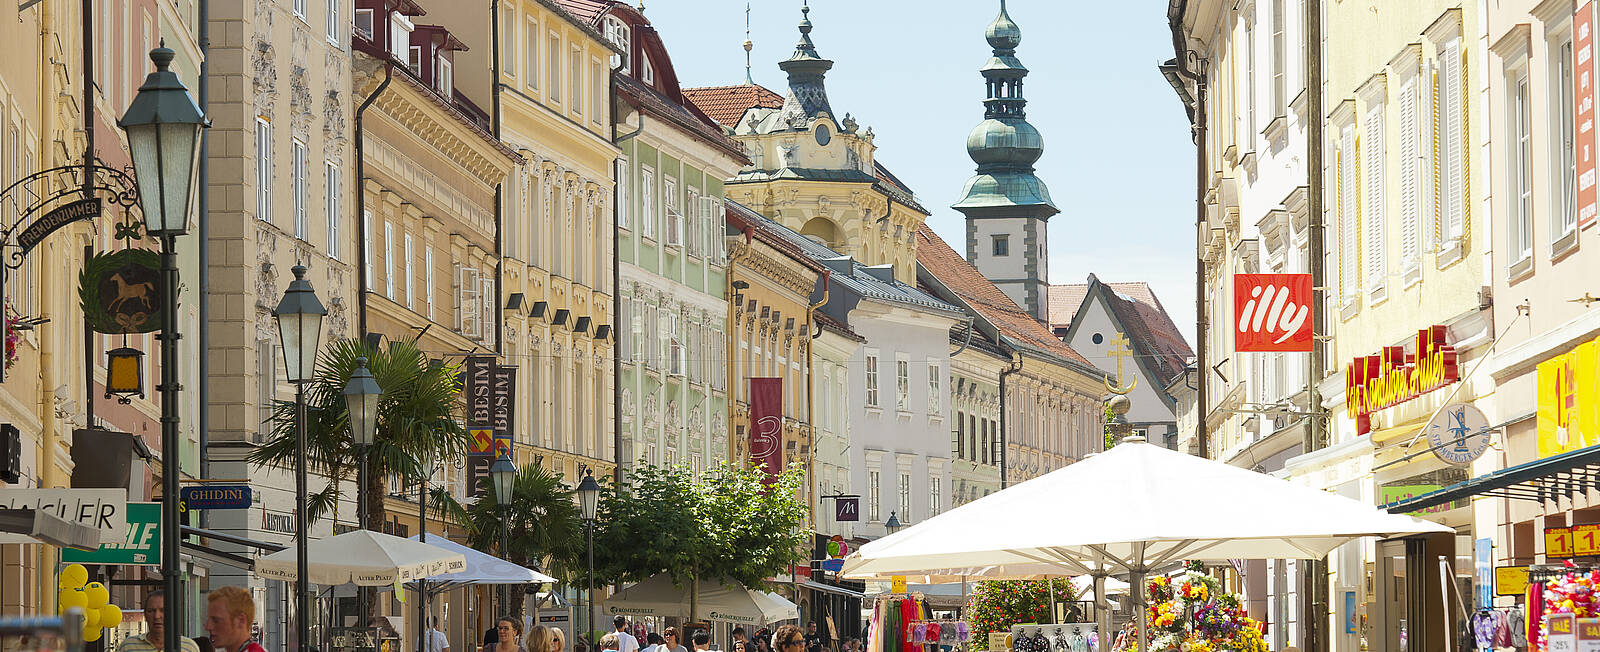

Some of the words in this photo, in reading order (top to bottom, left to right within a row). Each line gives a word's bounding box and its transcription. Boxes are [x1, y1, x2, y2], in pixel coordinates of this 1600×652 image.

[21, 202, 98, 247] FREMDENZIMMER
[1239, 284, 1309, 344] illy
[474, 361, 490, 423] BESIM
[495, 372, 509, 432] BESIM
[751, 415, 781, 459] 3
[189, 489, 243, 500] GHIDINI
[839, 501, 855, 517] M
